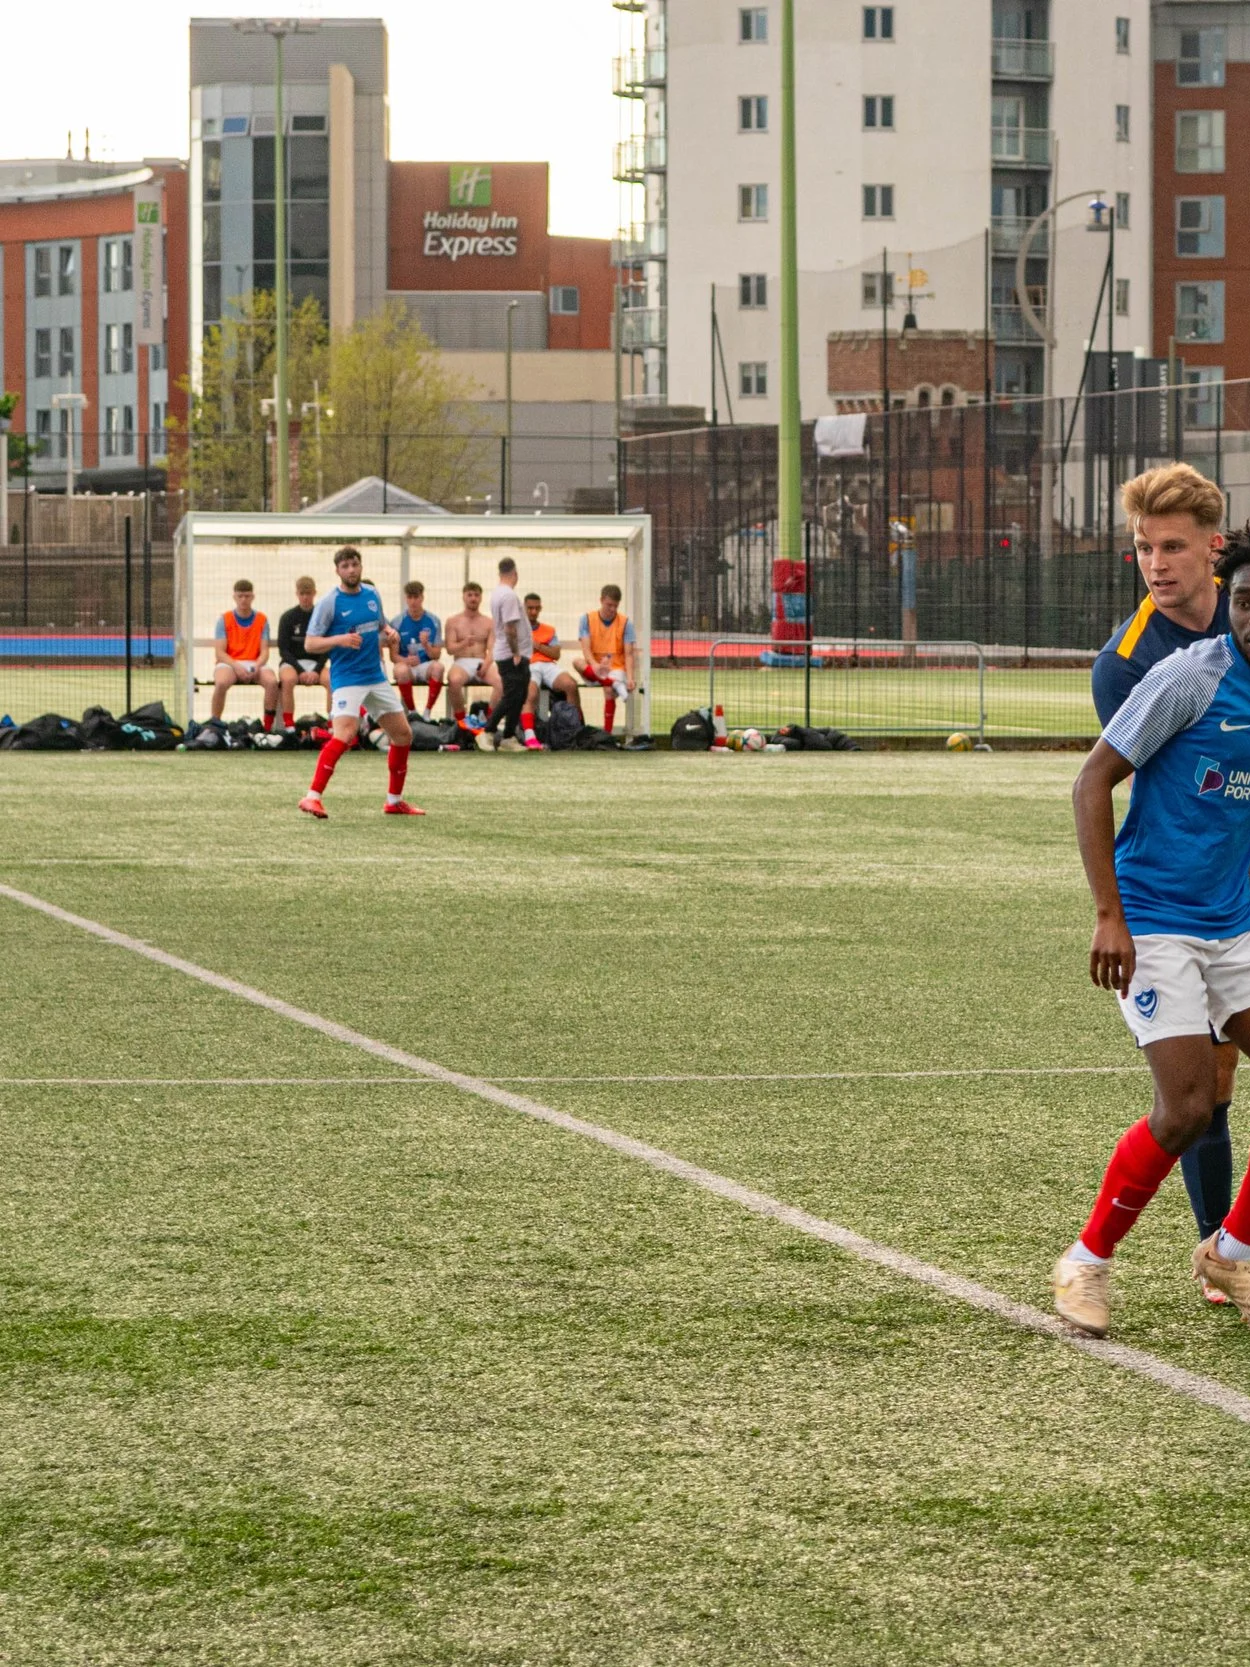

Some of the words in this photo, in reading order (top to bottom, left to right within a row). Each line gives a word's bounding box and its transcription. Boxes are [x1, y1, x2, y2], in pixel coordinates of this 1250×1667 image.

[423, 211, 489, 233] Holiday
[491, 211, 518, 229] Inn
[423, 231, 518, 261] Express
